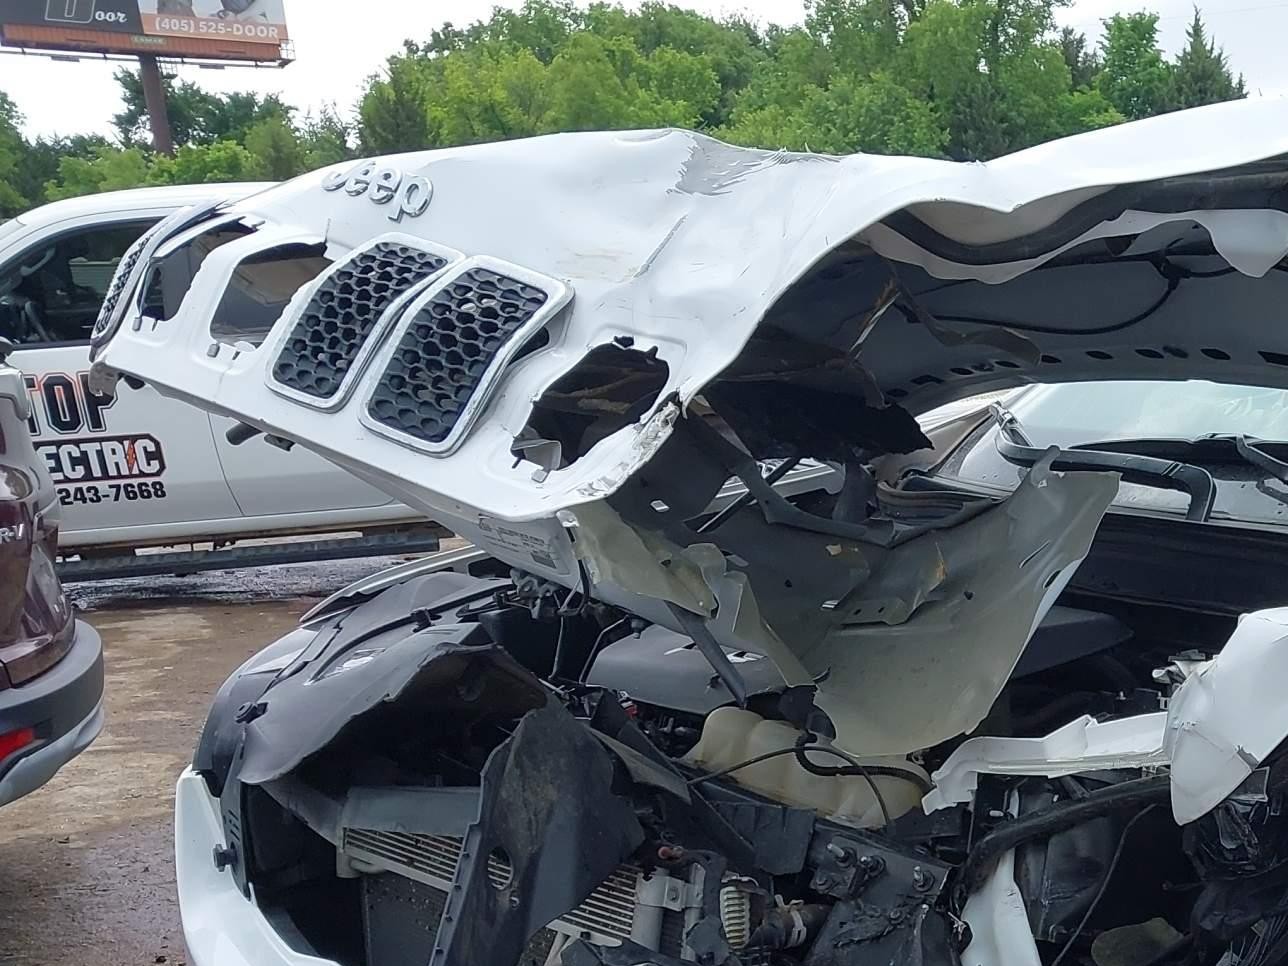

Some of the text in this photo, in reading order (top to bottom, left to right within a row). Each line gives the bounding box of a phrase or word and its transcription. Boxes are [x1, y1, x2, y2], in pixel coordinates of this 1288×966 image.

[155, 17, 278, 38] (405) 525-DOOR
[57, 481, 167, 506] 243-7668
